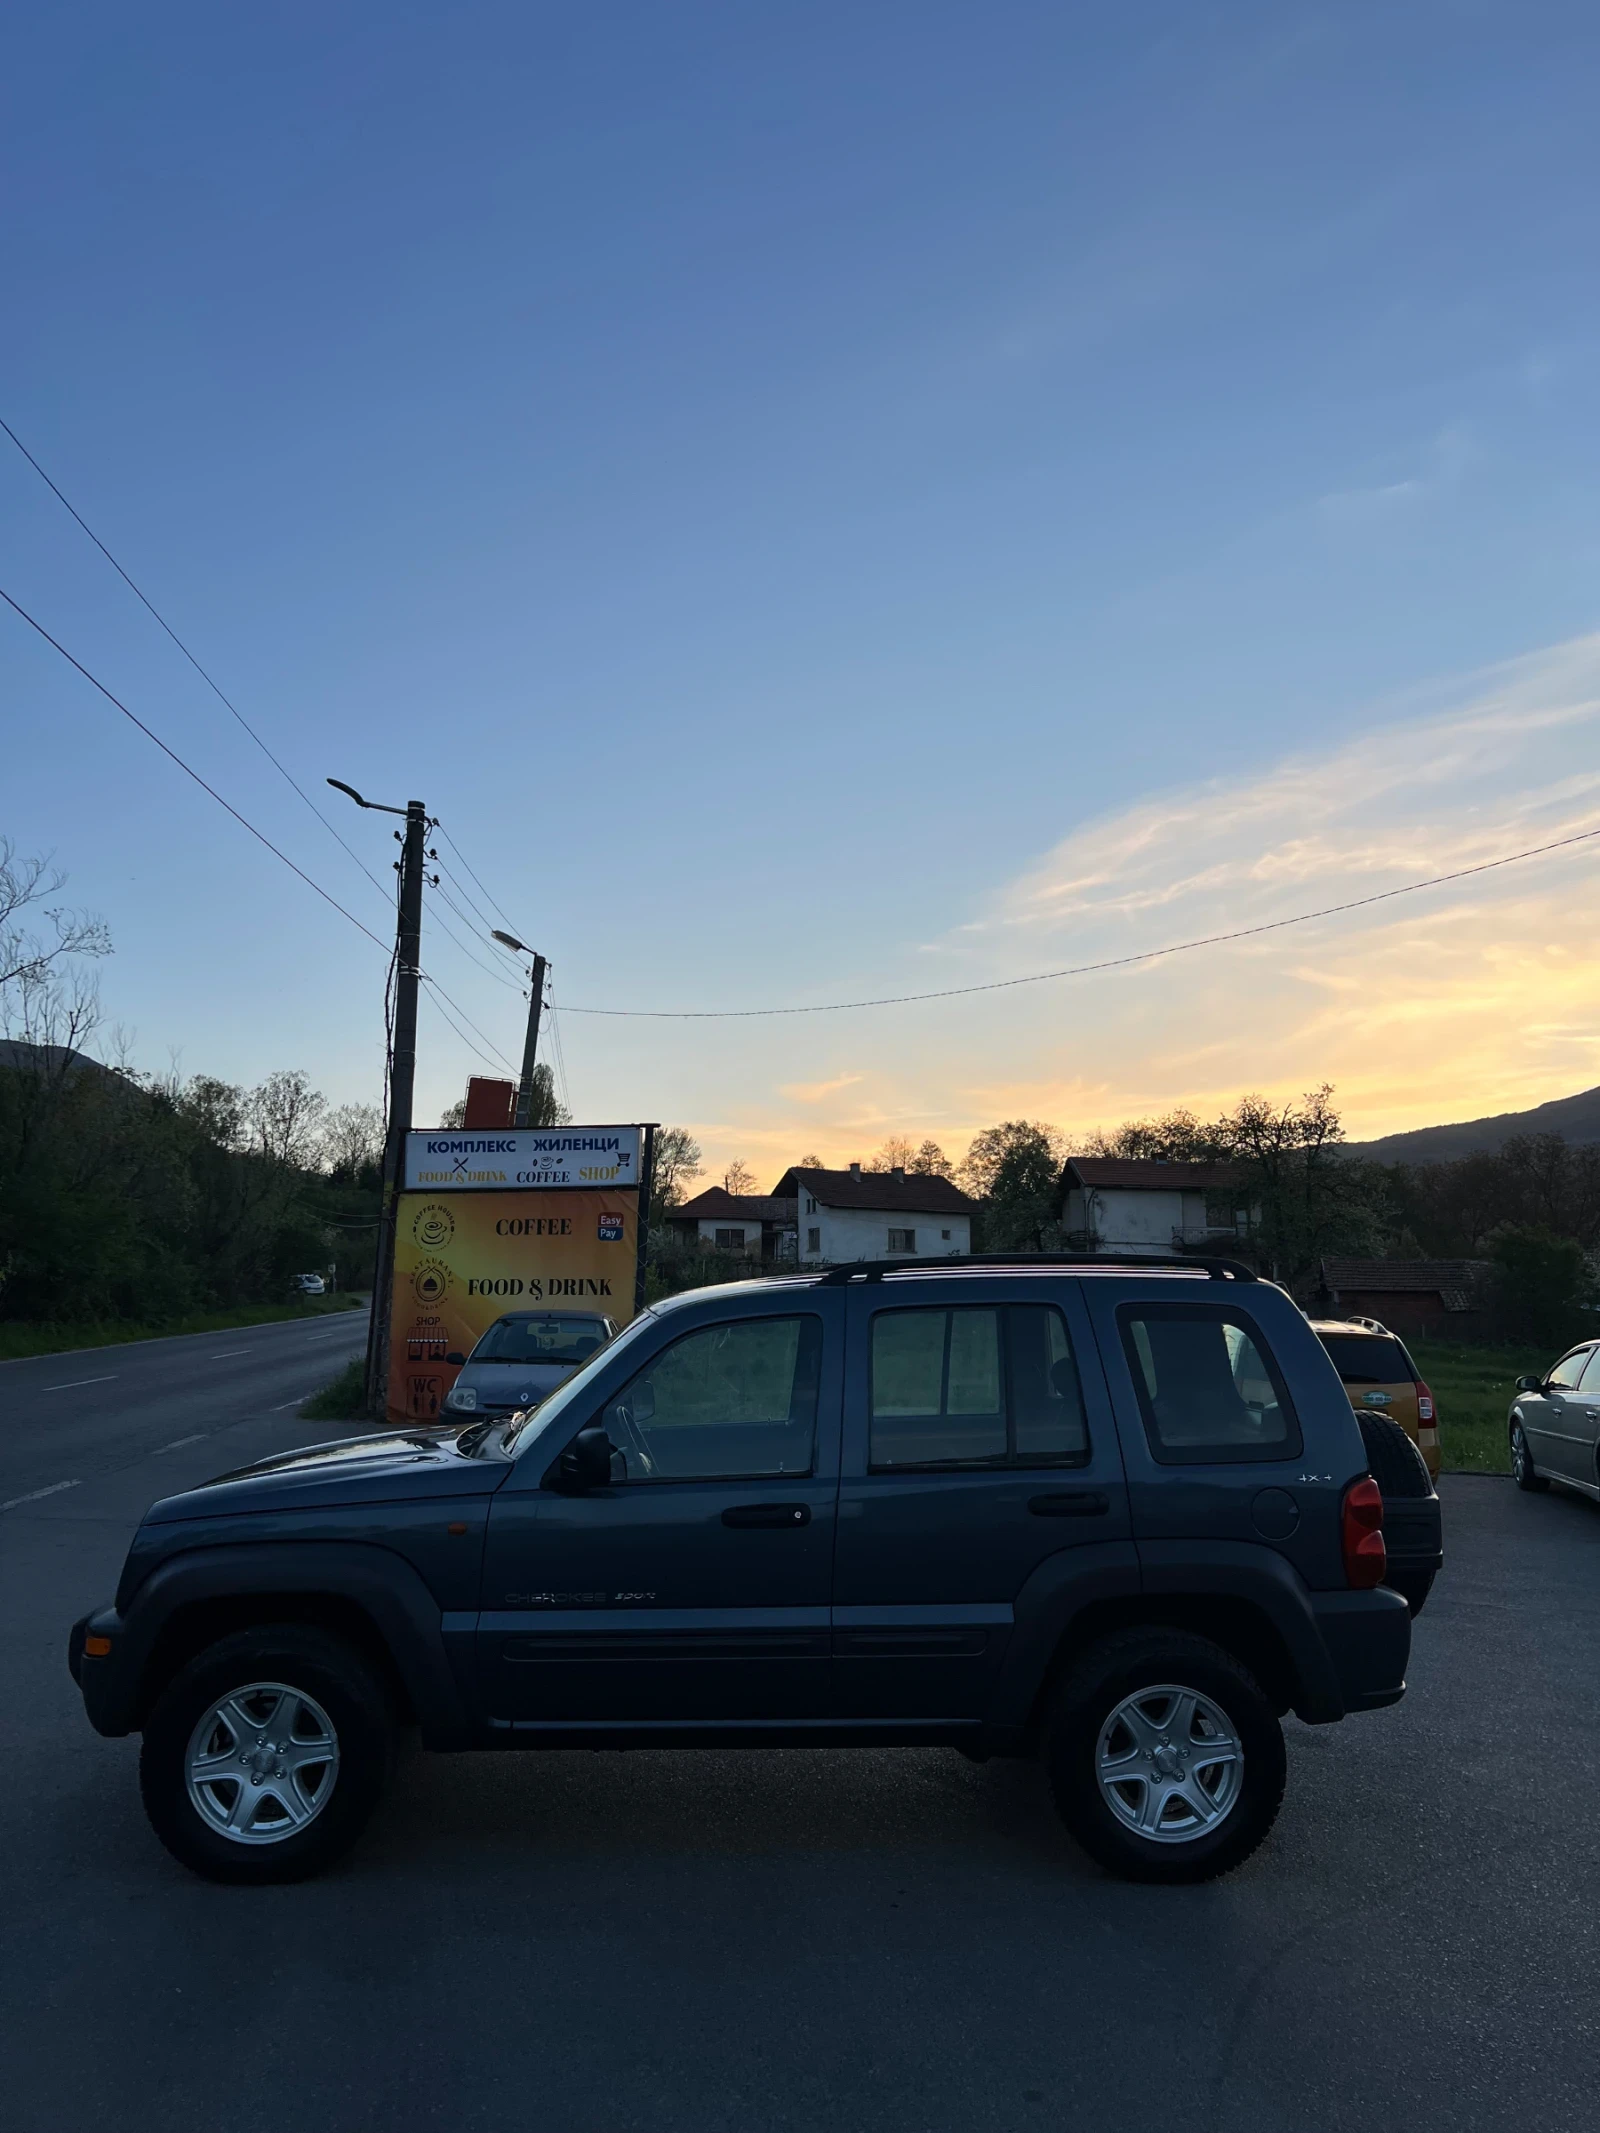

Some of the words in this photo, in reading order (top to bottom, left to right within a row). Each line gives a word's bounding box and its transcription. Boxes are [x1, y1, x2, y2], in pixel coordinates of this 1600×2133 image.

[427, 1140, 516, 1154] КОМПЛЕКС
[533, 1138, 619, 1152] ЖИЛЕНЦИ
[418, 1172, 453, 1182] FOOD
[455, 1172, 465, 1184] &
[467, 1171, 507, 1182] DRINK
[516, 1171, 570, 1183] COFFEE
[578, 1167, 620, 1180] SHOP
[495, 1218, 572, 1236] COFFEE
[600, 1215, 621, 1226] Easy
[600, 1228, 616, 1239] Pay
[467, 1278, 523, 1296] FOOD
[528, 1279, 543, 1300] &
[548, 1278, 612, 1296] DRINK
[416, 1316, 440, 1326] SHOP
[413, 1378, 436, 1393] WC
[505, 1592, 606, 1603] CHEROKEE
